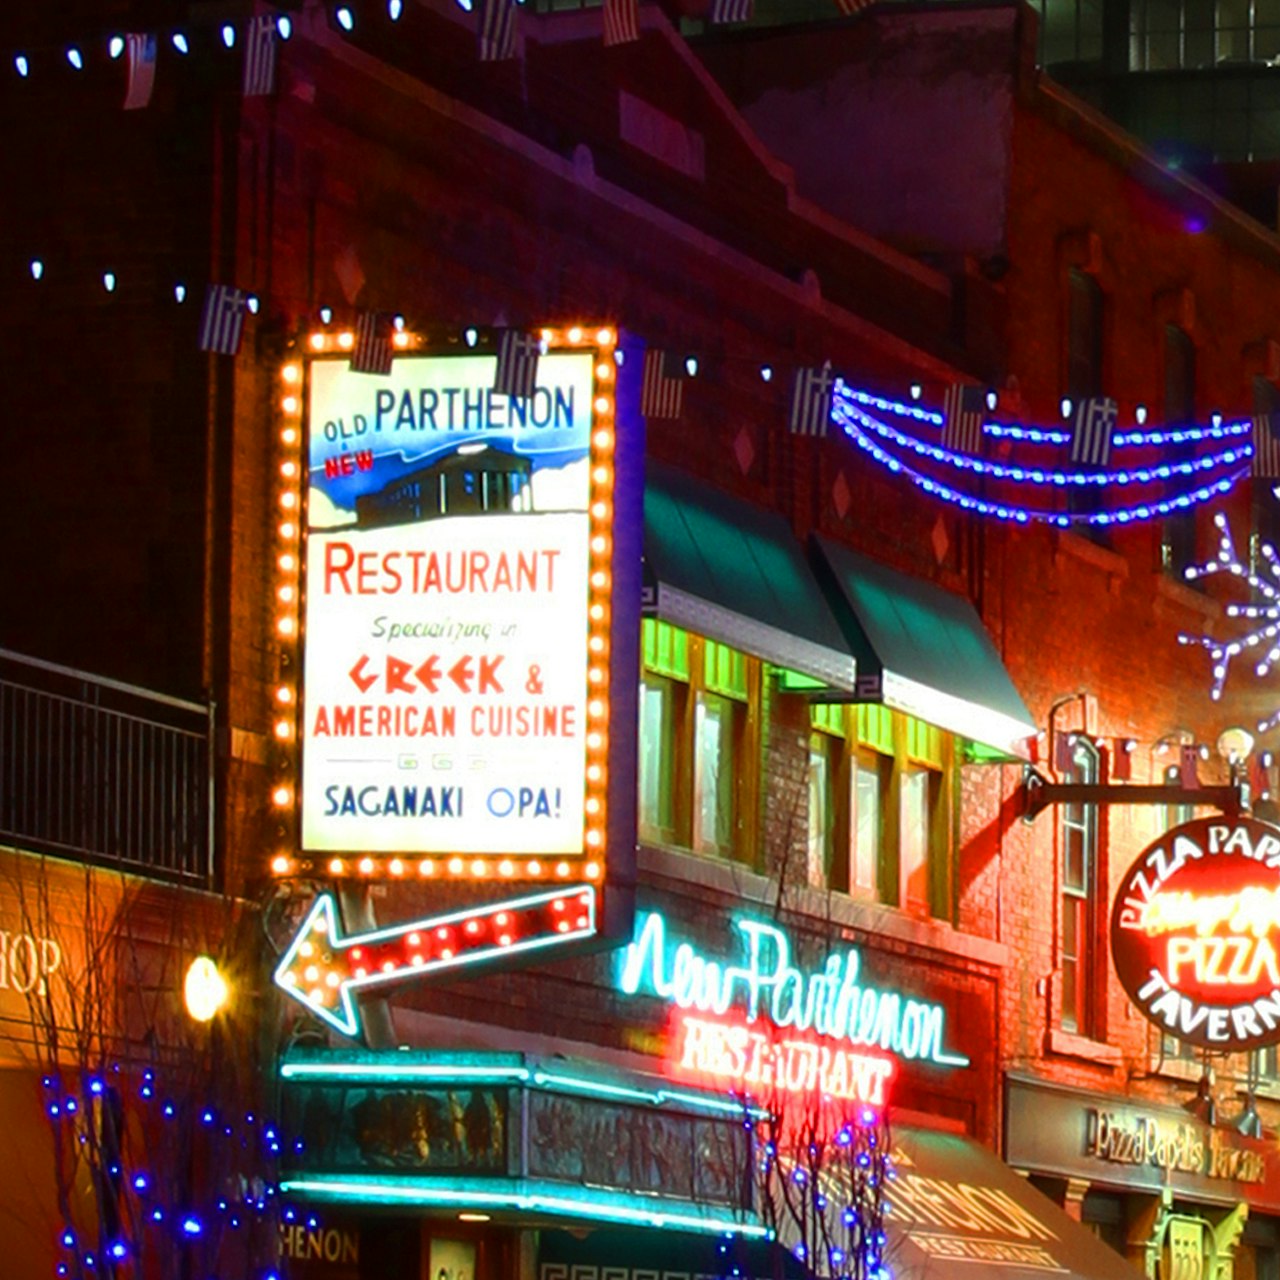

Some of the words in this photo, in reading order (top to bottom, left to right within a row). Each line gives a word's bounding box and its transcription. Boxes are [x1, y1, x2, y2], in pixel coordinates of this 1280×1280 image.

[324, 414, 367, 443] OLD
[374, 384, 575, 432] PARTHENON
[324, 448, 374, 480] NEW
[324, 541, 561, 595] RESTAURANT
[371, 615, 491, 643] Specializing
[348, 654, 505, 695] GREEK
[524, 664, 544, 695] &
[313, 705, 456, 738] AMERICAN
[470, 704, 576, 738] CUISINE
[324, 784, 463, 818] SAGANAKI
[486, 787, 561, 819] OPA!
[1120, 835, 1204, 930] PIZZA
[621, 912, 729, 1015] New
[735, 918, 970, 1067] Parthenon
